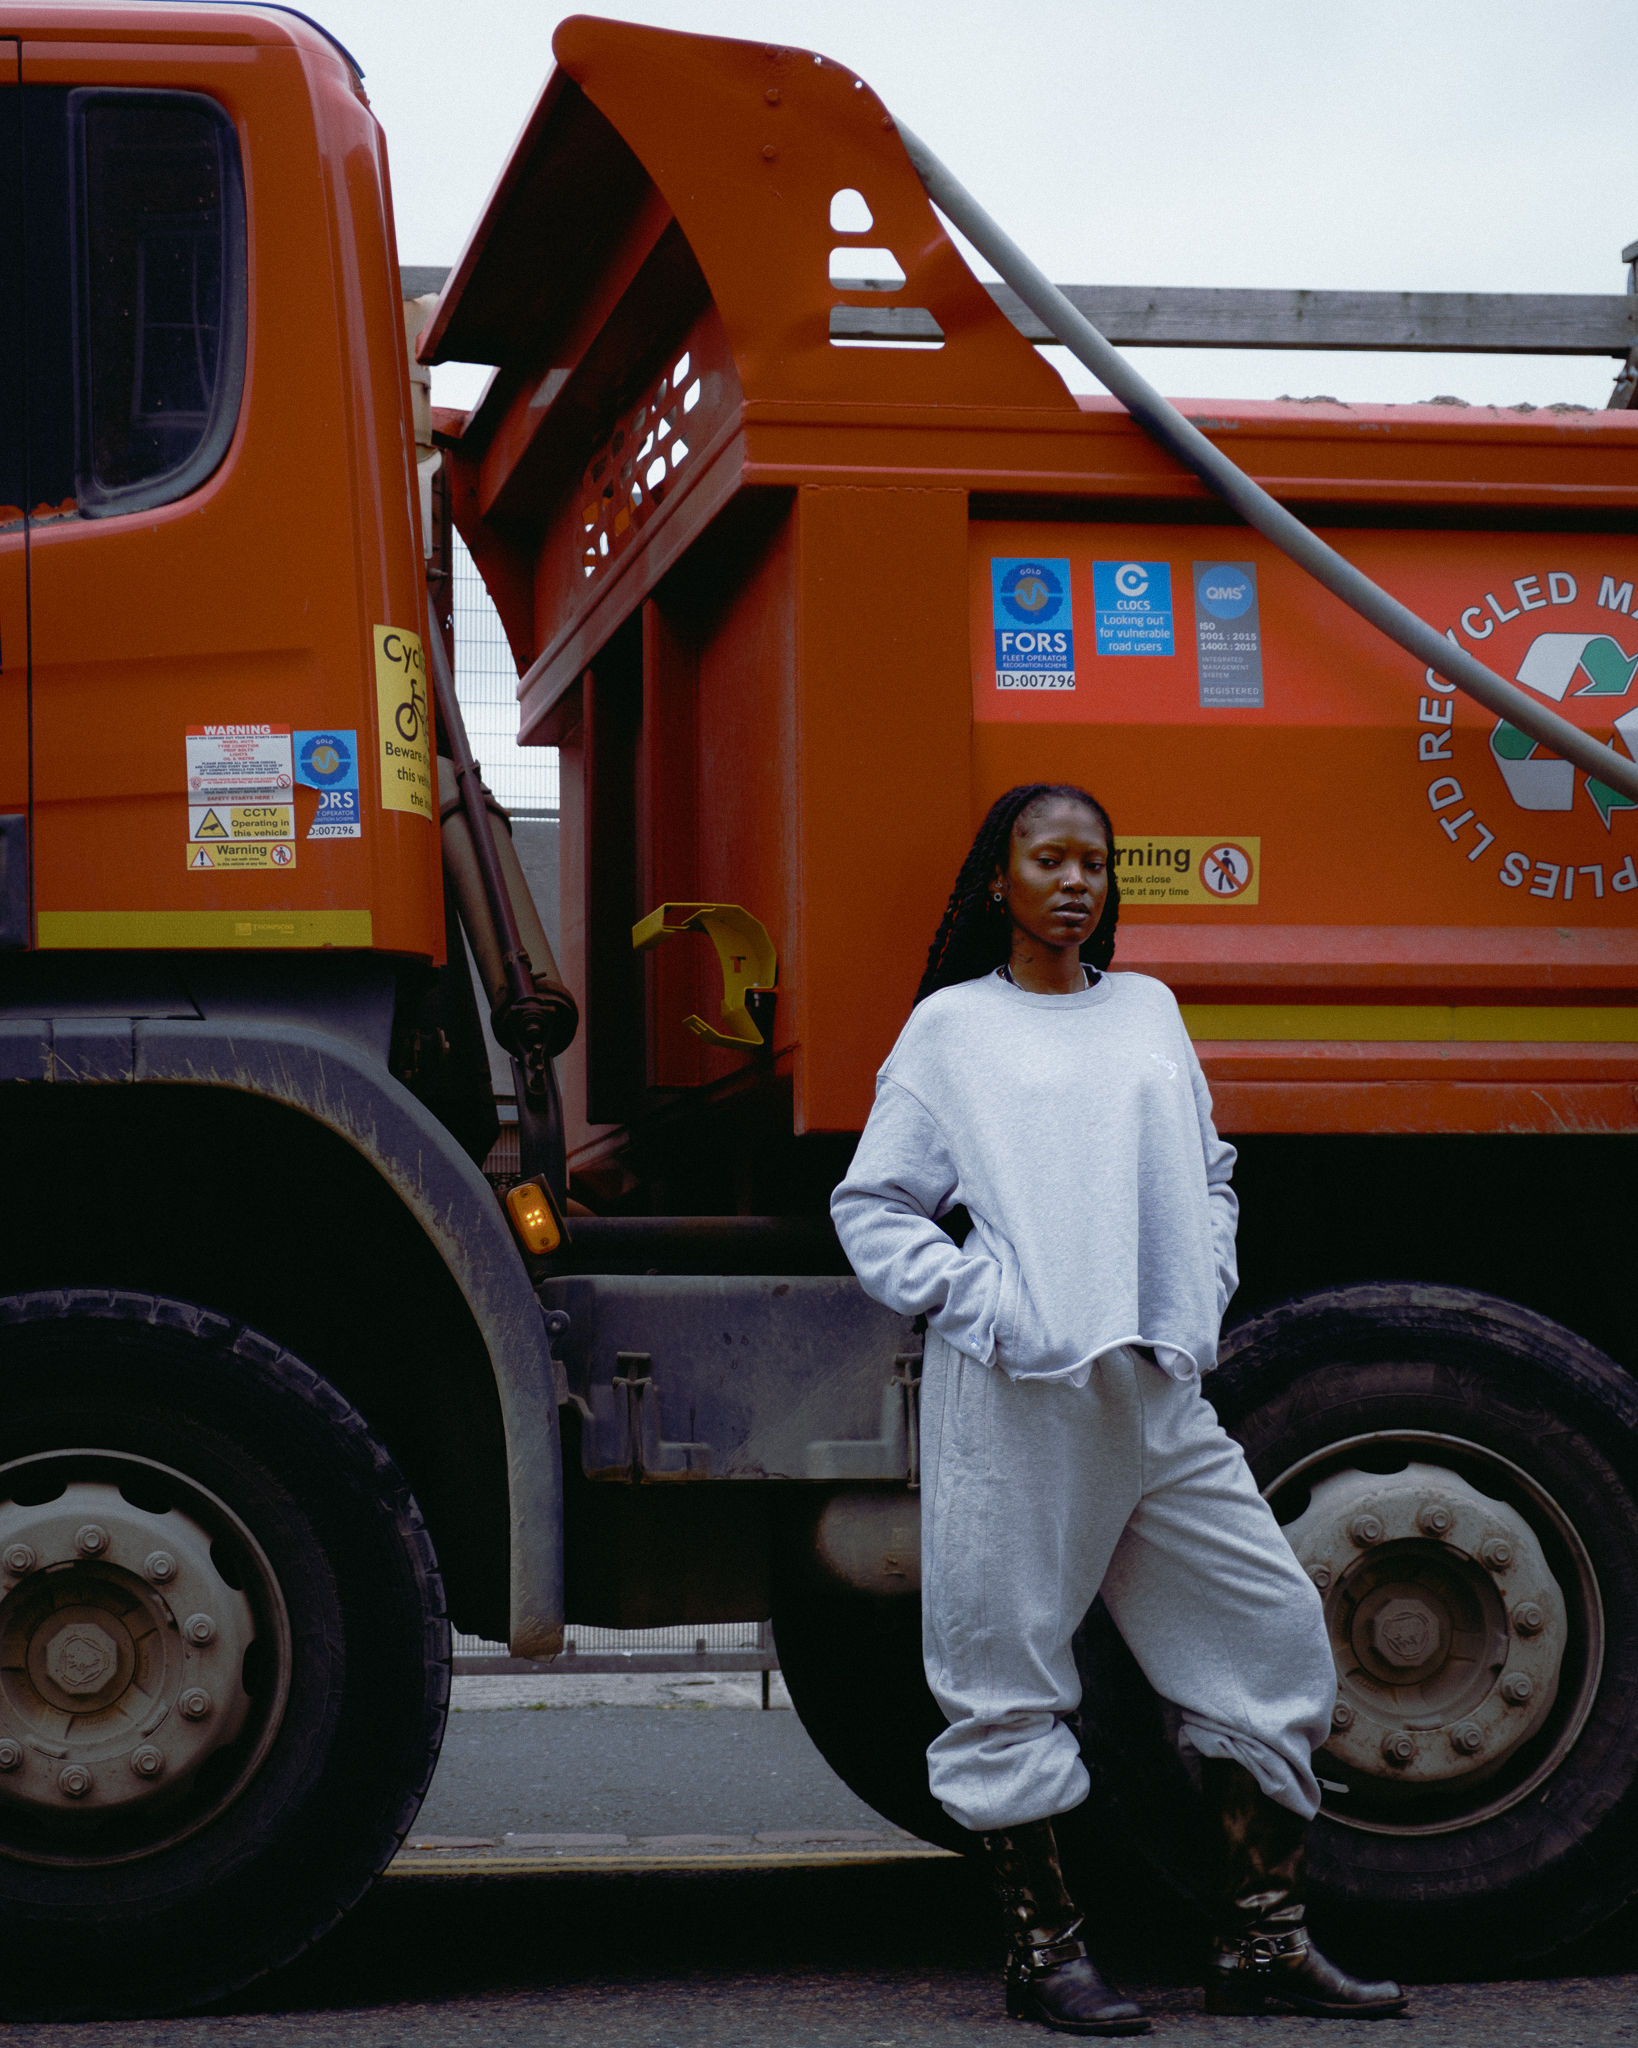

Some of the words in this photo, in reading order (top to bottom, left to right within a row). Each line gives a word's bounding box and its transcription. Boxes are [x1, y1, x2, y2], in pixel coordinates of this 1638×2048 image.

[1020, 568, 1042, 576] GOLD
[1206, 587, 1242, 600] QMS
[1596, 575, 1638, 619] M
[1116, 600, 1150, 610] CLOCS
[1104, 615, 1144, 627] Looking
[1146, 616, 1164, 625] out
[1200, 622, 1215, 630] ISO
[1100, 628, 1114, 638] for
[1117, 628, 1170, 638] vulnerable
[1002, 632, 1067, 653] FORS
[1109, 642, 1131, 651] road
[1134, 643, 1162, 651] users
[998, 675, 1075, 688] ID:007296
[204, 725, 271, 735] WARNING
[386, 741, 422, 762] Beware
[397, 766, 415, 782] this
[318, 792, 354, 809] ORS
[411, 792, 423, 807] the
[243, 808, 277, 817] CCTV
[231, 820, 278, 828] Operating
[1427, 776, 1496, 862] LTD
[308, 826, 354, 836] D:007296
[217, 845, 267, 856] Warning
[1116, 842, 1190, 872] rning
[1122, 875, 1143, 883] walk
[1146, 875, 1171, 883] close
[1499, 851, 1638, 900] PLIES
[1149, 889, 1166, 897] any
[1168, 887, 1189, 896] time
